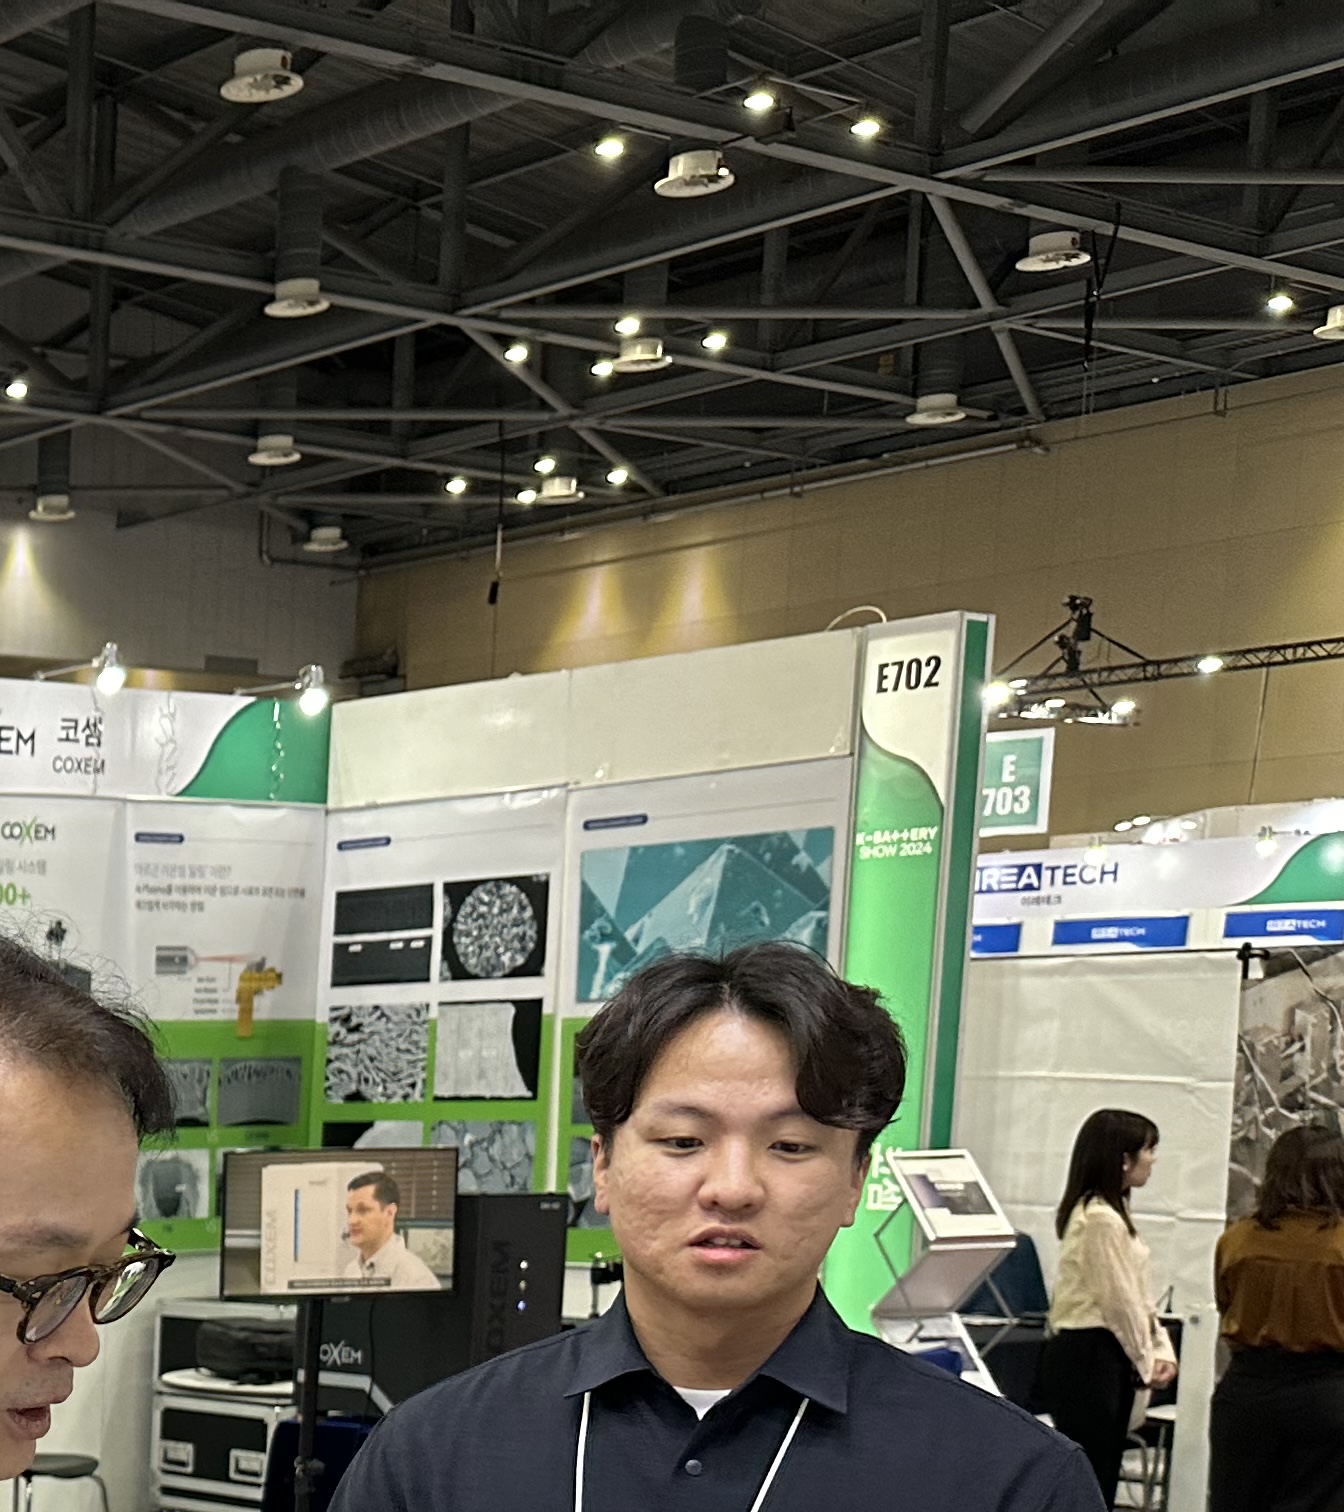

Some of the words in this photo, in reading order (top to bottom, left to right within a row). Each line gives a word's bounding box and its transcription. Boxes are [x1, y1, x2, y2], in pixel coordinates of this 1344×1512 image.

[876, 655, 942, 694] E702
[1001, 754, 1017, 783] E
[982, 785, 1031, 816] 703
[1, 816, 56, 845] COXEM
[859, 845, 897, 859] SHOW
[900, 841, 932, 856] 2024
